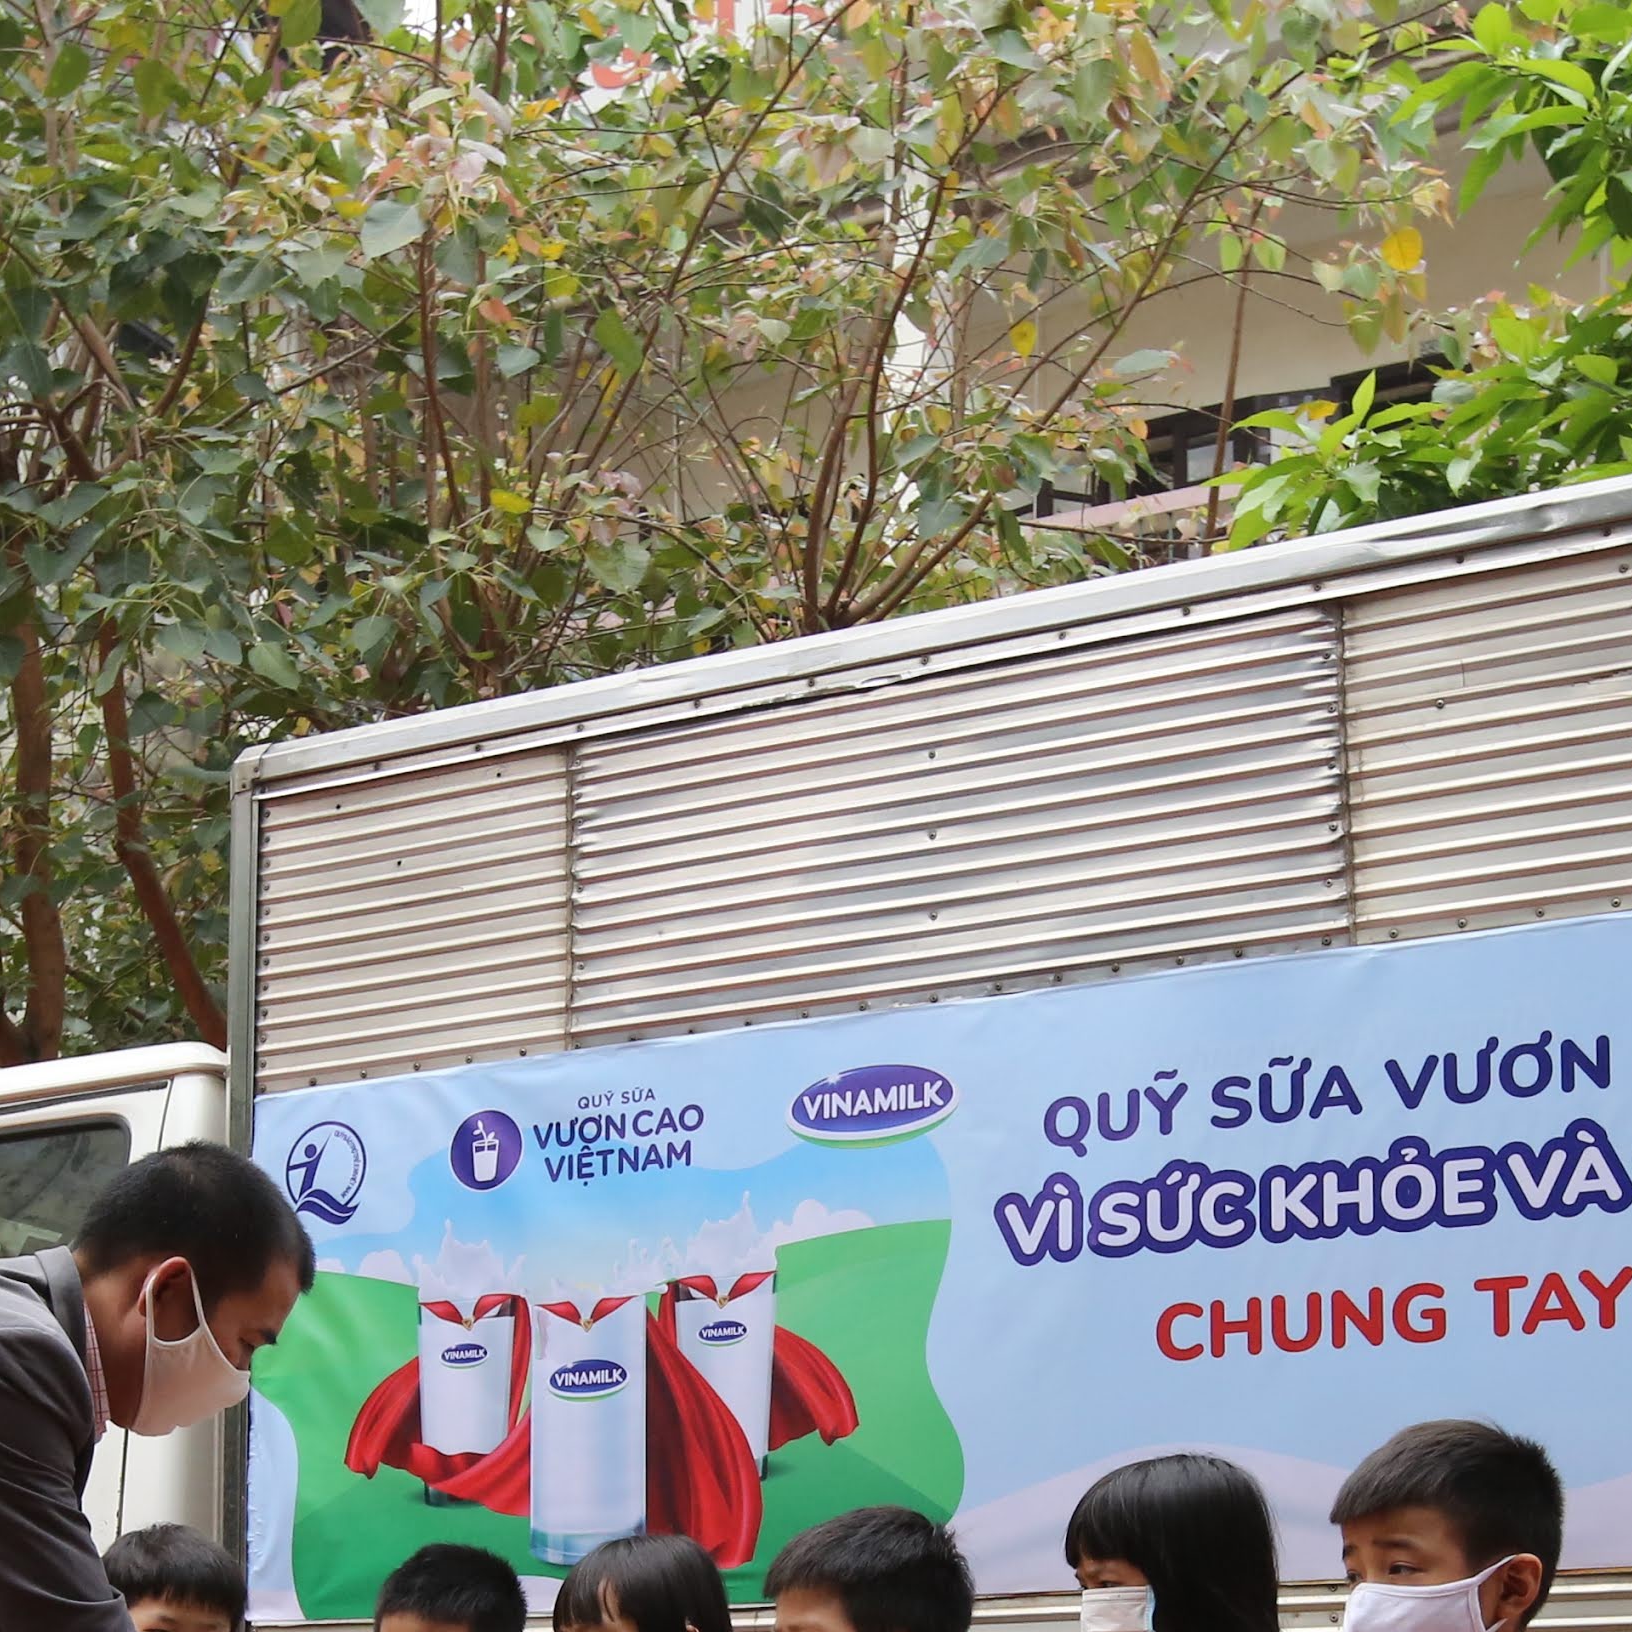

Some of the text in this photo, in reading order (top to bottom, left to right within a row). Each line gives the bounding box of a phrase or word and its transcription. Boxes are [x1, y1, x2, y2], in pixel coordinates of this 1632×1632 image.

[577, 1086, 656, 1109] QUỸ SỮA
[802, 1079, 945, 1121] VINAMILK
[1043, 1068, 1188, 1158] QUỸ
[1210, 1054, 1362, 1130] SỮA
[1384, 1030, 1611, 1110] VƯƠN
[532, 1103, 705, 1149] VƯƠN CAO
[544, 1139, 692, 1188] VIỆT NAM
[999, 1176, 1077, 1260] VÌ
[1095, 1163, 1250, 1252] SỨC
[1265, 1141, 1488, 1236] KHỎE
[1502, 1124, 1625, 1210] VÀ
[701, 1326, 746, 1339] VINAMILK
[1156, 1280, 1448, 1361] CHUNG
[443, 1347, 486, 1360] VINAMILK
[554, 1367, 624, 1387] VINAMILK
